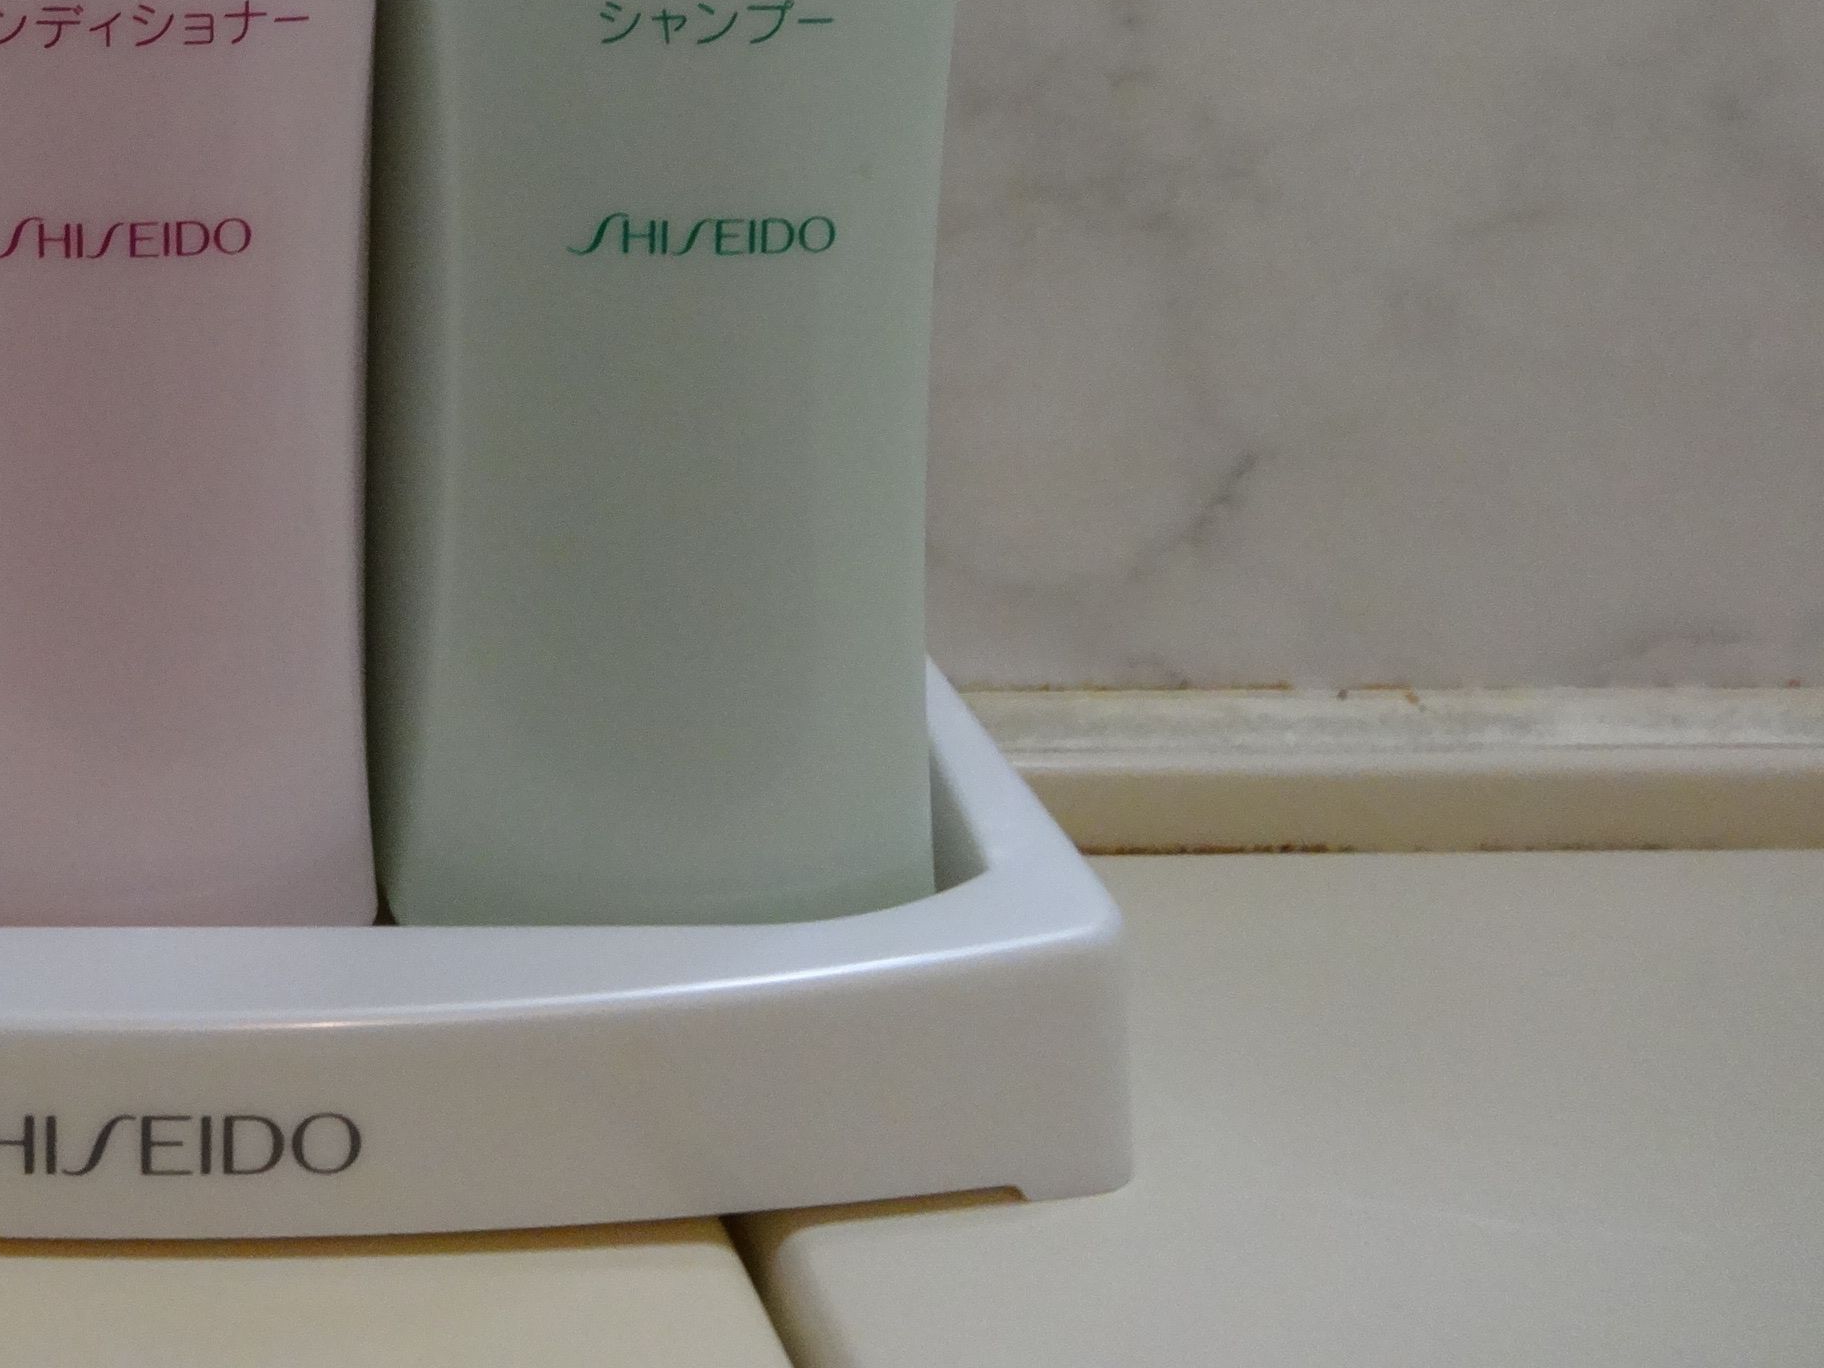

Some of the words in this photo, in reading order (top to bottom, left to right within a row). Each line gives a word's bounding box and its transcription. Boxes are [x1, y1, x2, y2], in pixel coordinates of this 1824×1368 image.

[599, 0, 835, 45] シャンプー
[566, 211, 837, 257] SHISEIDO
